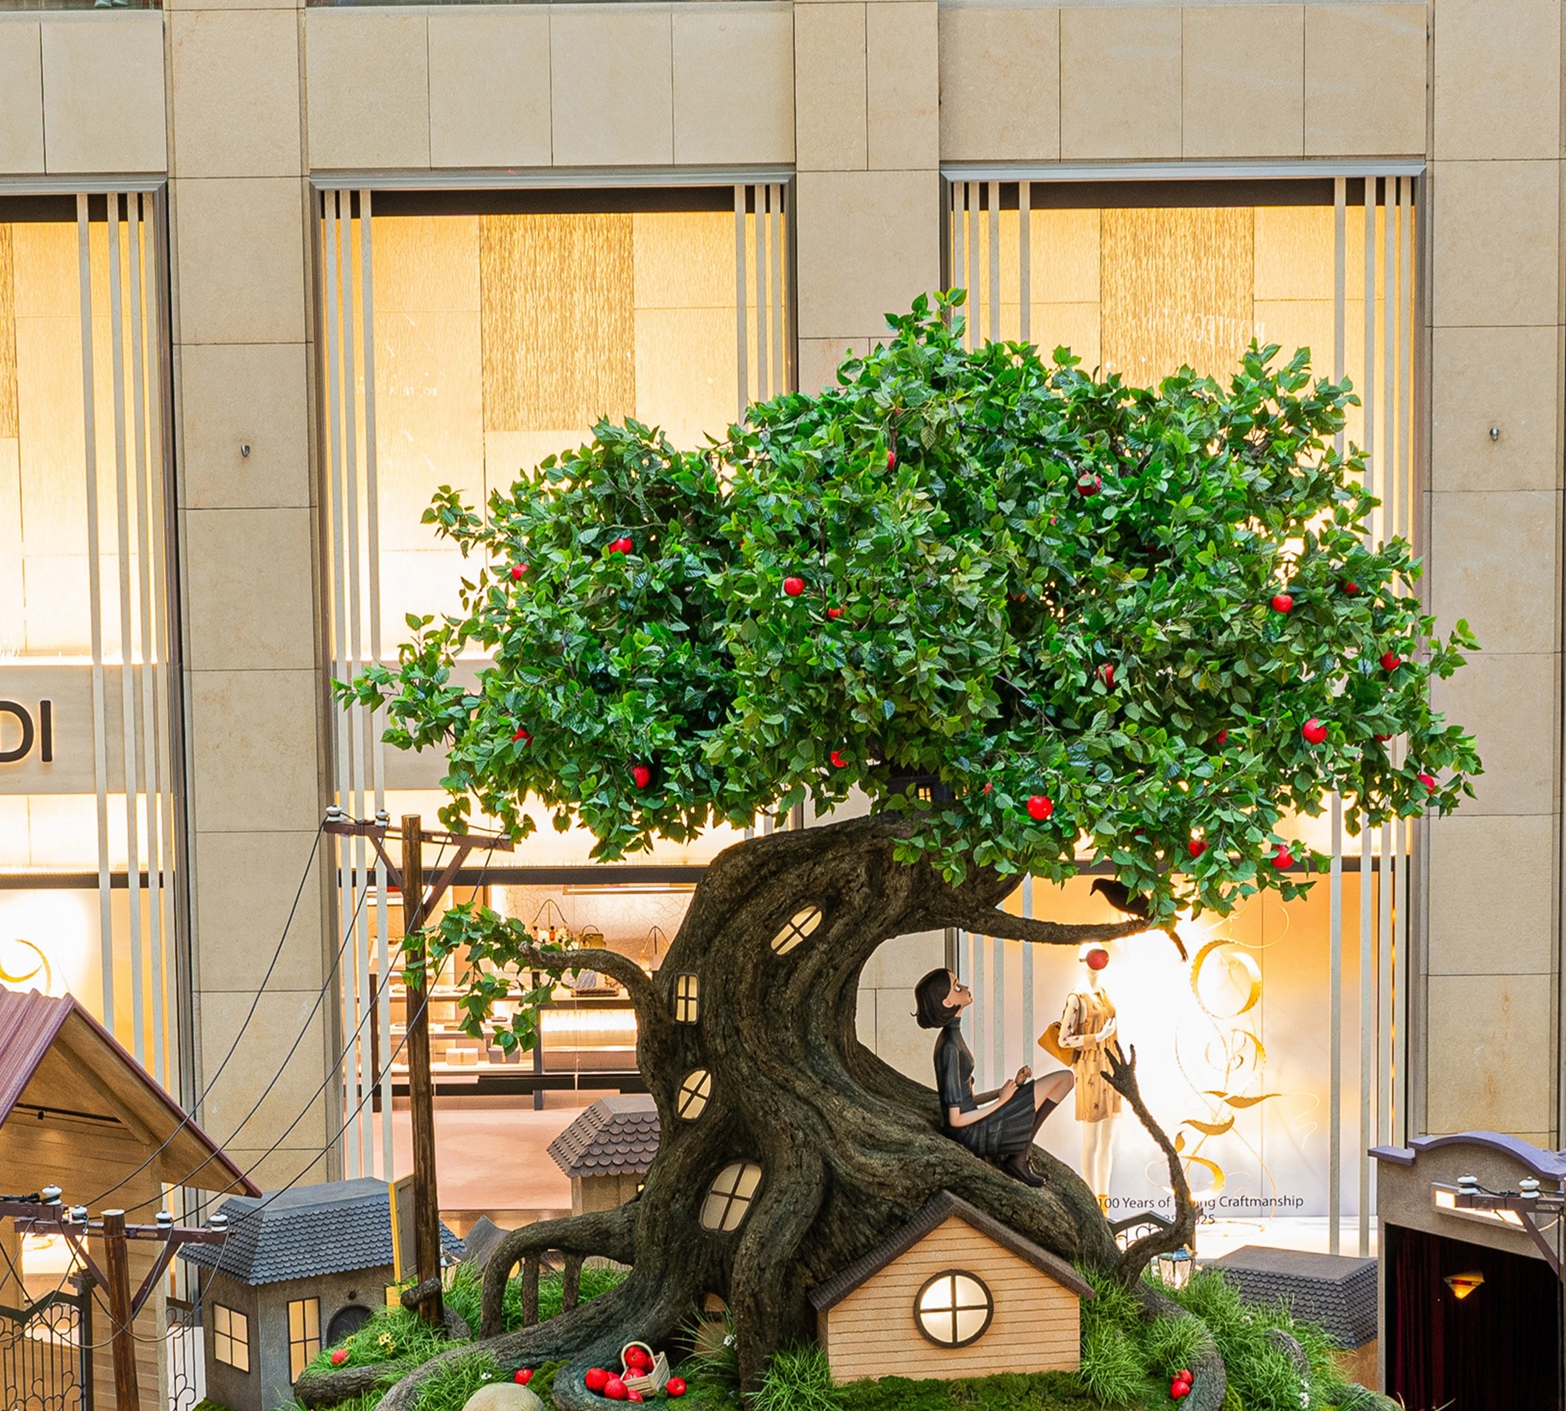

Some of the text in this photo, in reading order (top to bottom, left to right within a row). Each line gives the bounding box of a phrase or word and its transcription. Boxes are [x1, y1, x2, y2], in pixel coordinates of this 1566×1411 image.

[1099, 1197, 1120, 1209] 100
[1122, 1197, 1154, 1209] Years
[1158, 1196, 1171, 1208] of
[1219, 1195, 1304, 1209] Craftmanship
